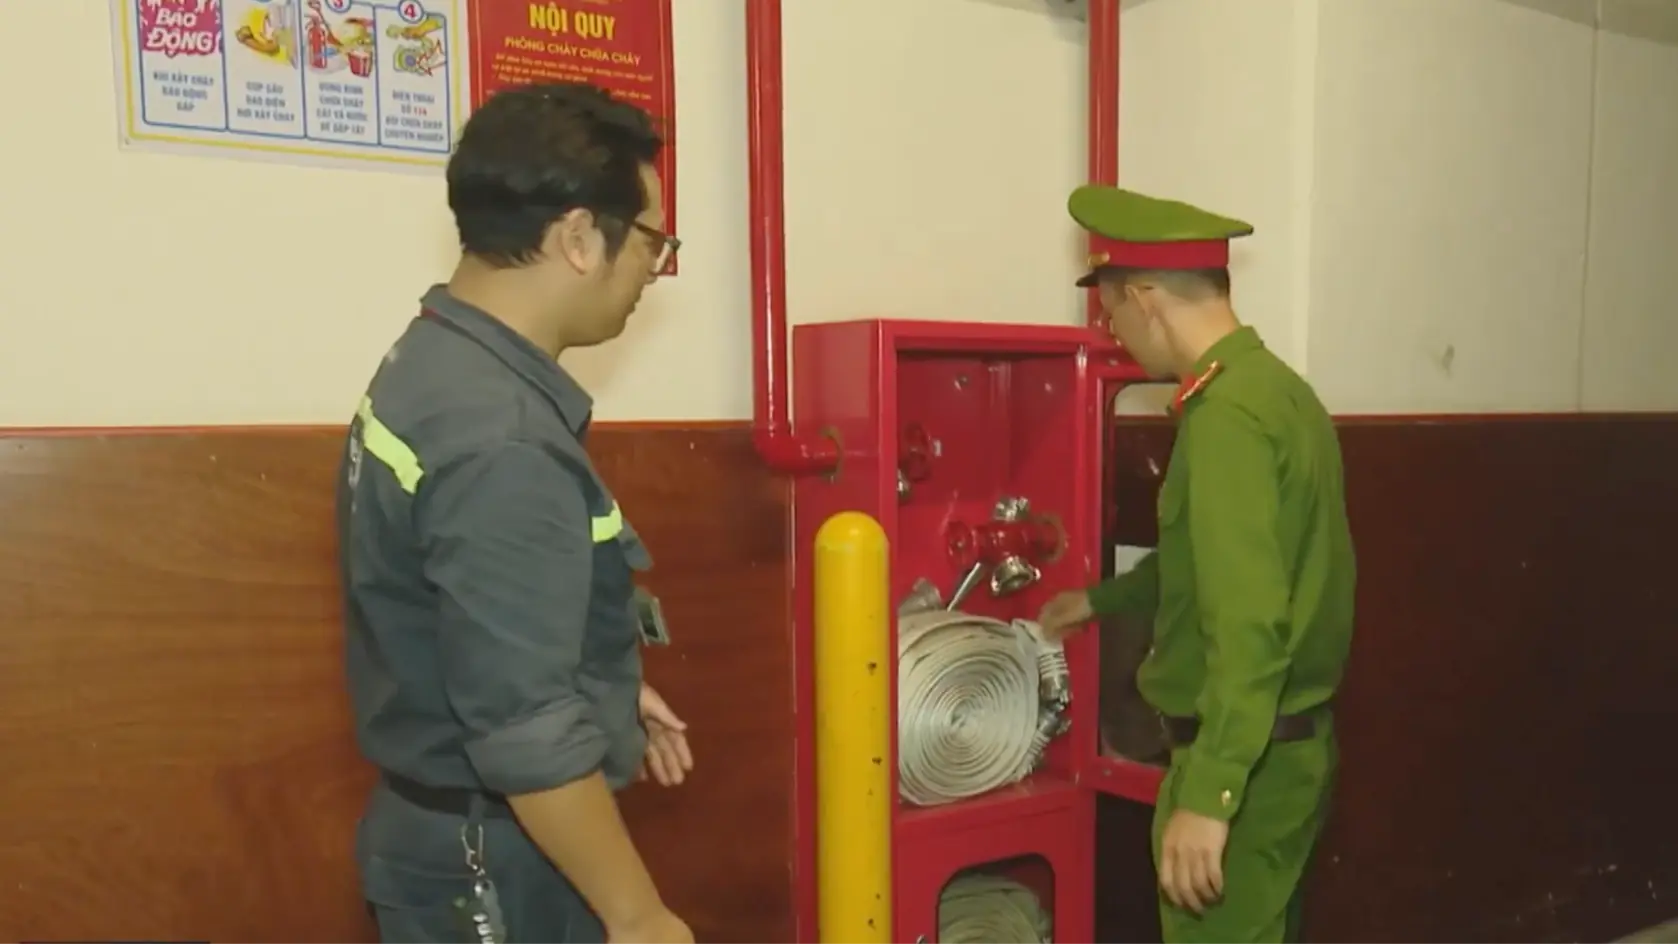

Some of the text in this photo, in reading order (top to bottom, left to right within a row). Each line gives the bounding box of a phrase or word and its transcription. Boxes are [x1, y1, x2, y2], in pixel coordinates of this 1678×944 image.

[156, 7, 197, 28] BÁO
[403, 3, 416, 18] 4
[529, 2, 615, 40] NỘI QUY
[146, 27, 213, 54] ĐỘNG
